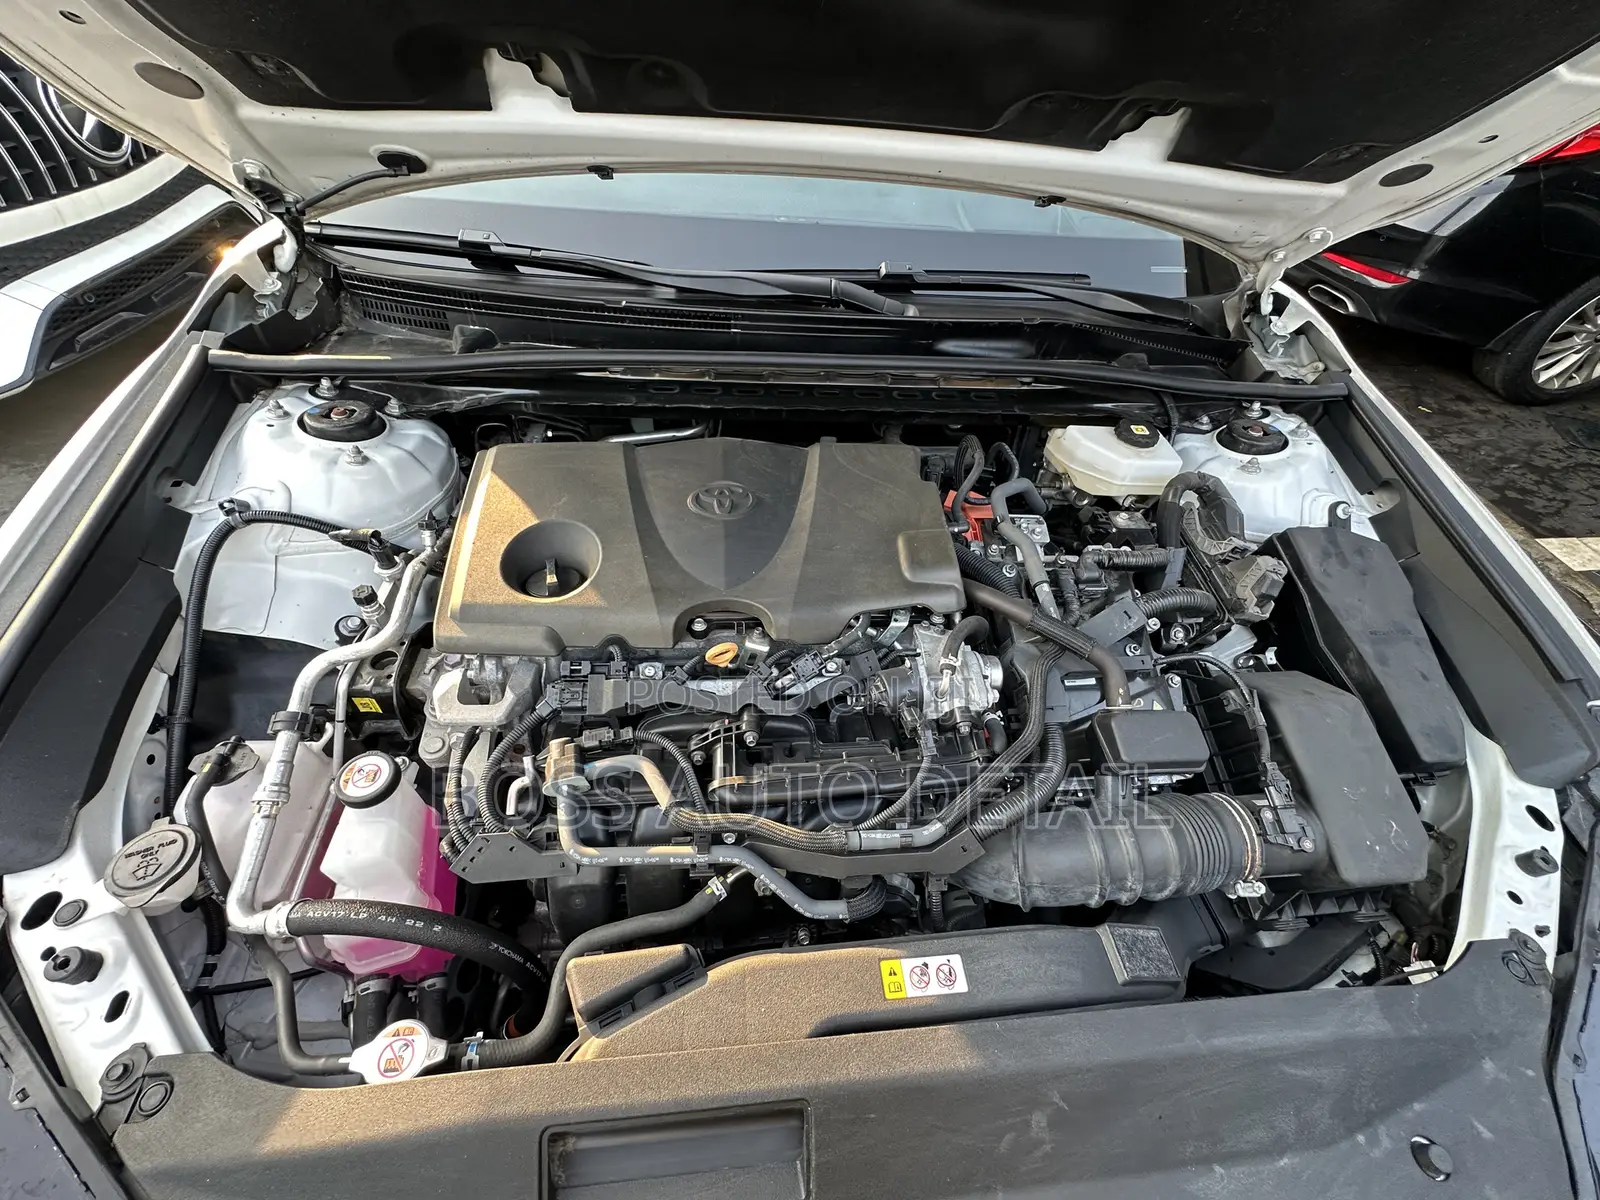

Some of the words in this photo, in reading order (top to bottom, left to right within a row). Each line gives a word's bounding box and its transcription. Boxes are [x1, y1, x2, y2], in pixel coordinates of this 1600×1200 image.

[125, 846, 154, 859] WASHER
[158, 839, 178, 849] FLUID
[140, 849, 160, 859] ONLY
[404, 918, 424, 928] 22
[497, 944, 525, 964] YOKOHAMA
